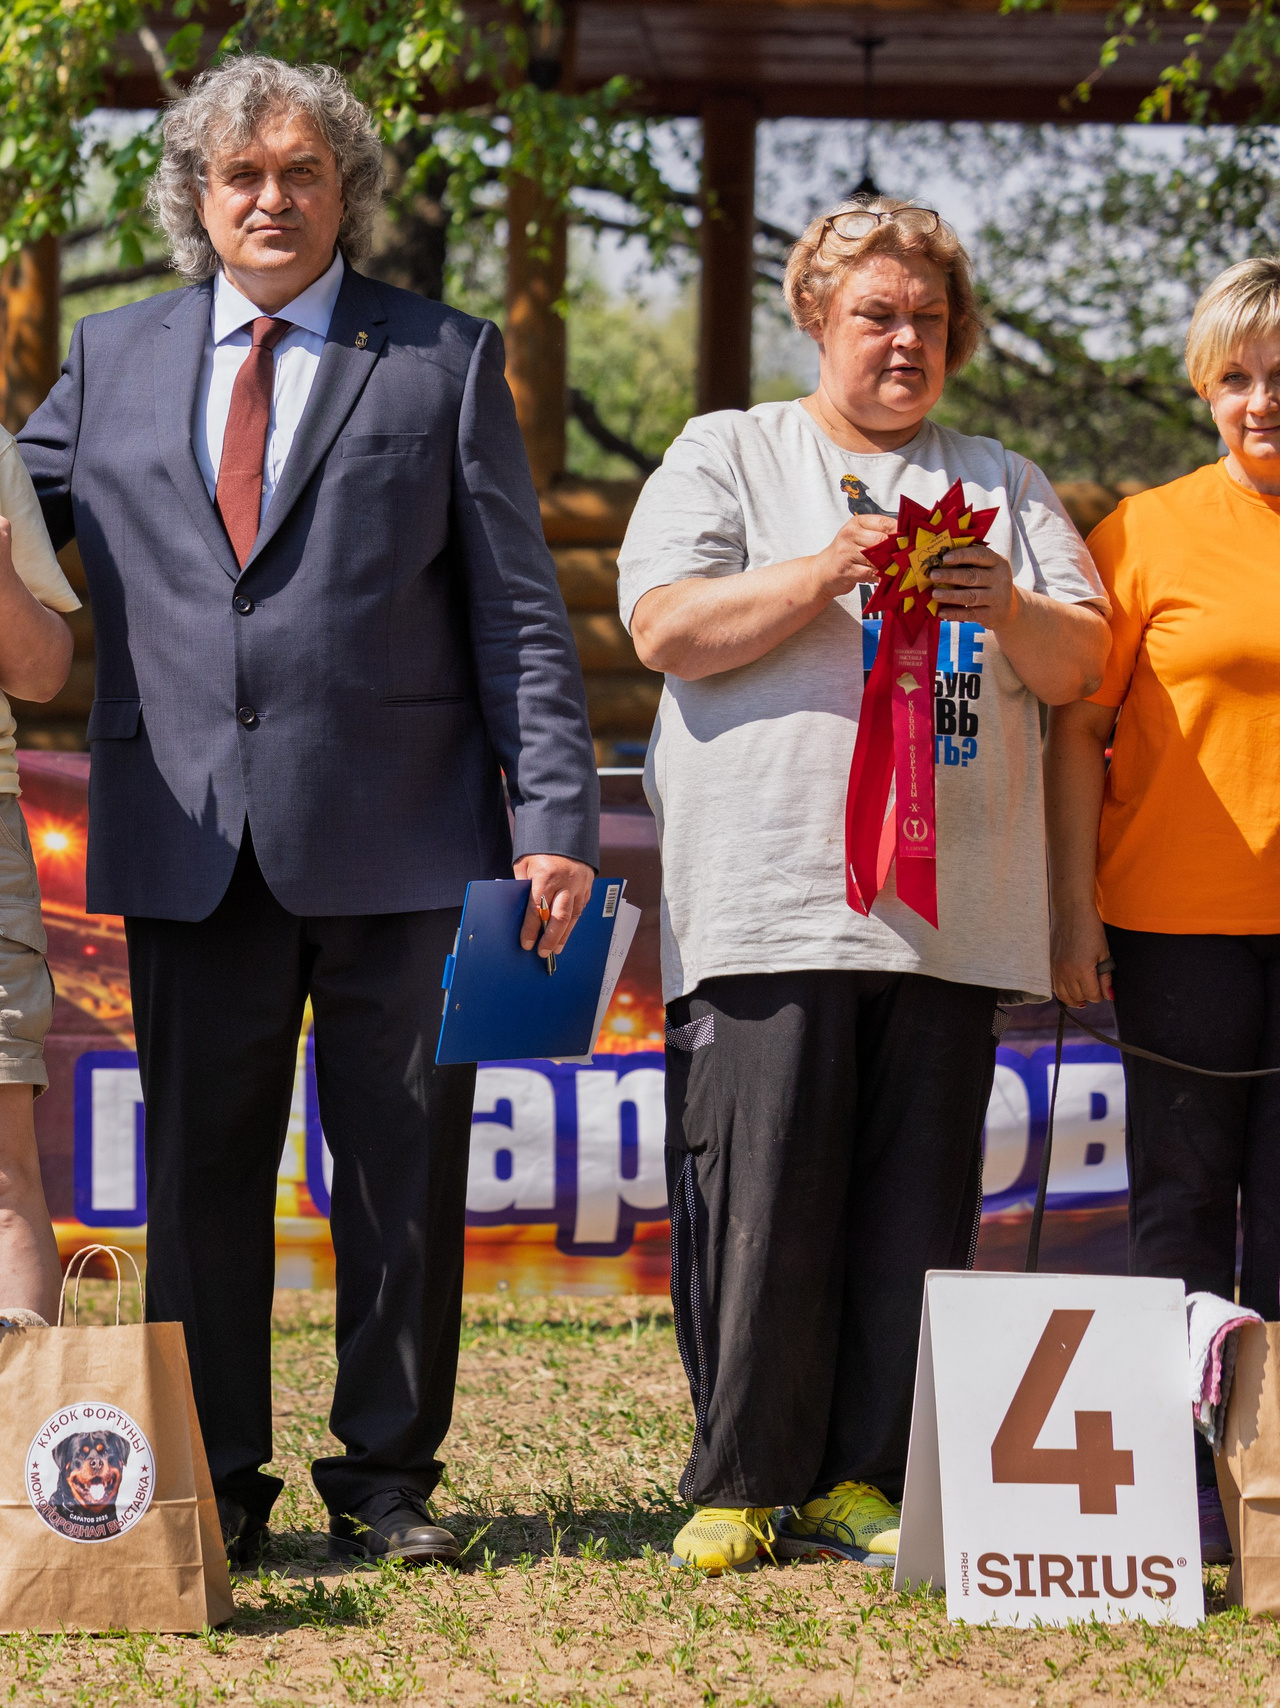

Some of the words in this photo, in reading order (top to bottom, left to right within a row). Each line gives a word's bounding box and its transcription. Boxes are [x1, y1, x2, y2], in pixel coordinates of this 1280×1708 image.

[908, 700, 916, 739] КУБОК
[908, 744, 918, 798] ФОРТУНЫ
[37, 1409, 79, 1449] КУБОК
[83, 1407, 146, 1454] ФОРТУНЫ
[991, 1309, 1135, 1515] 4
[30, 1471, 107, 1538] МОНОПОРОДНАЯ
[107, 1475, 150, 1534] ВЫСТАВКА
[69, 1513, 95, 1523] САРАТОВ
[961, 1552, 970, 1597] PREMIUM
